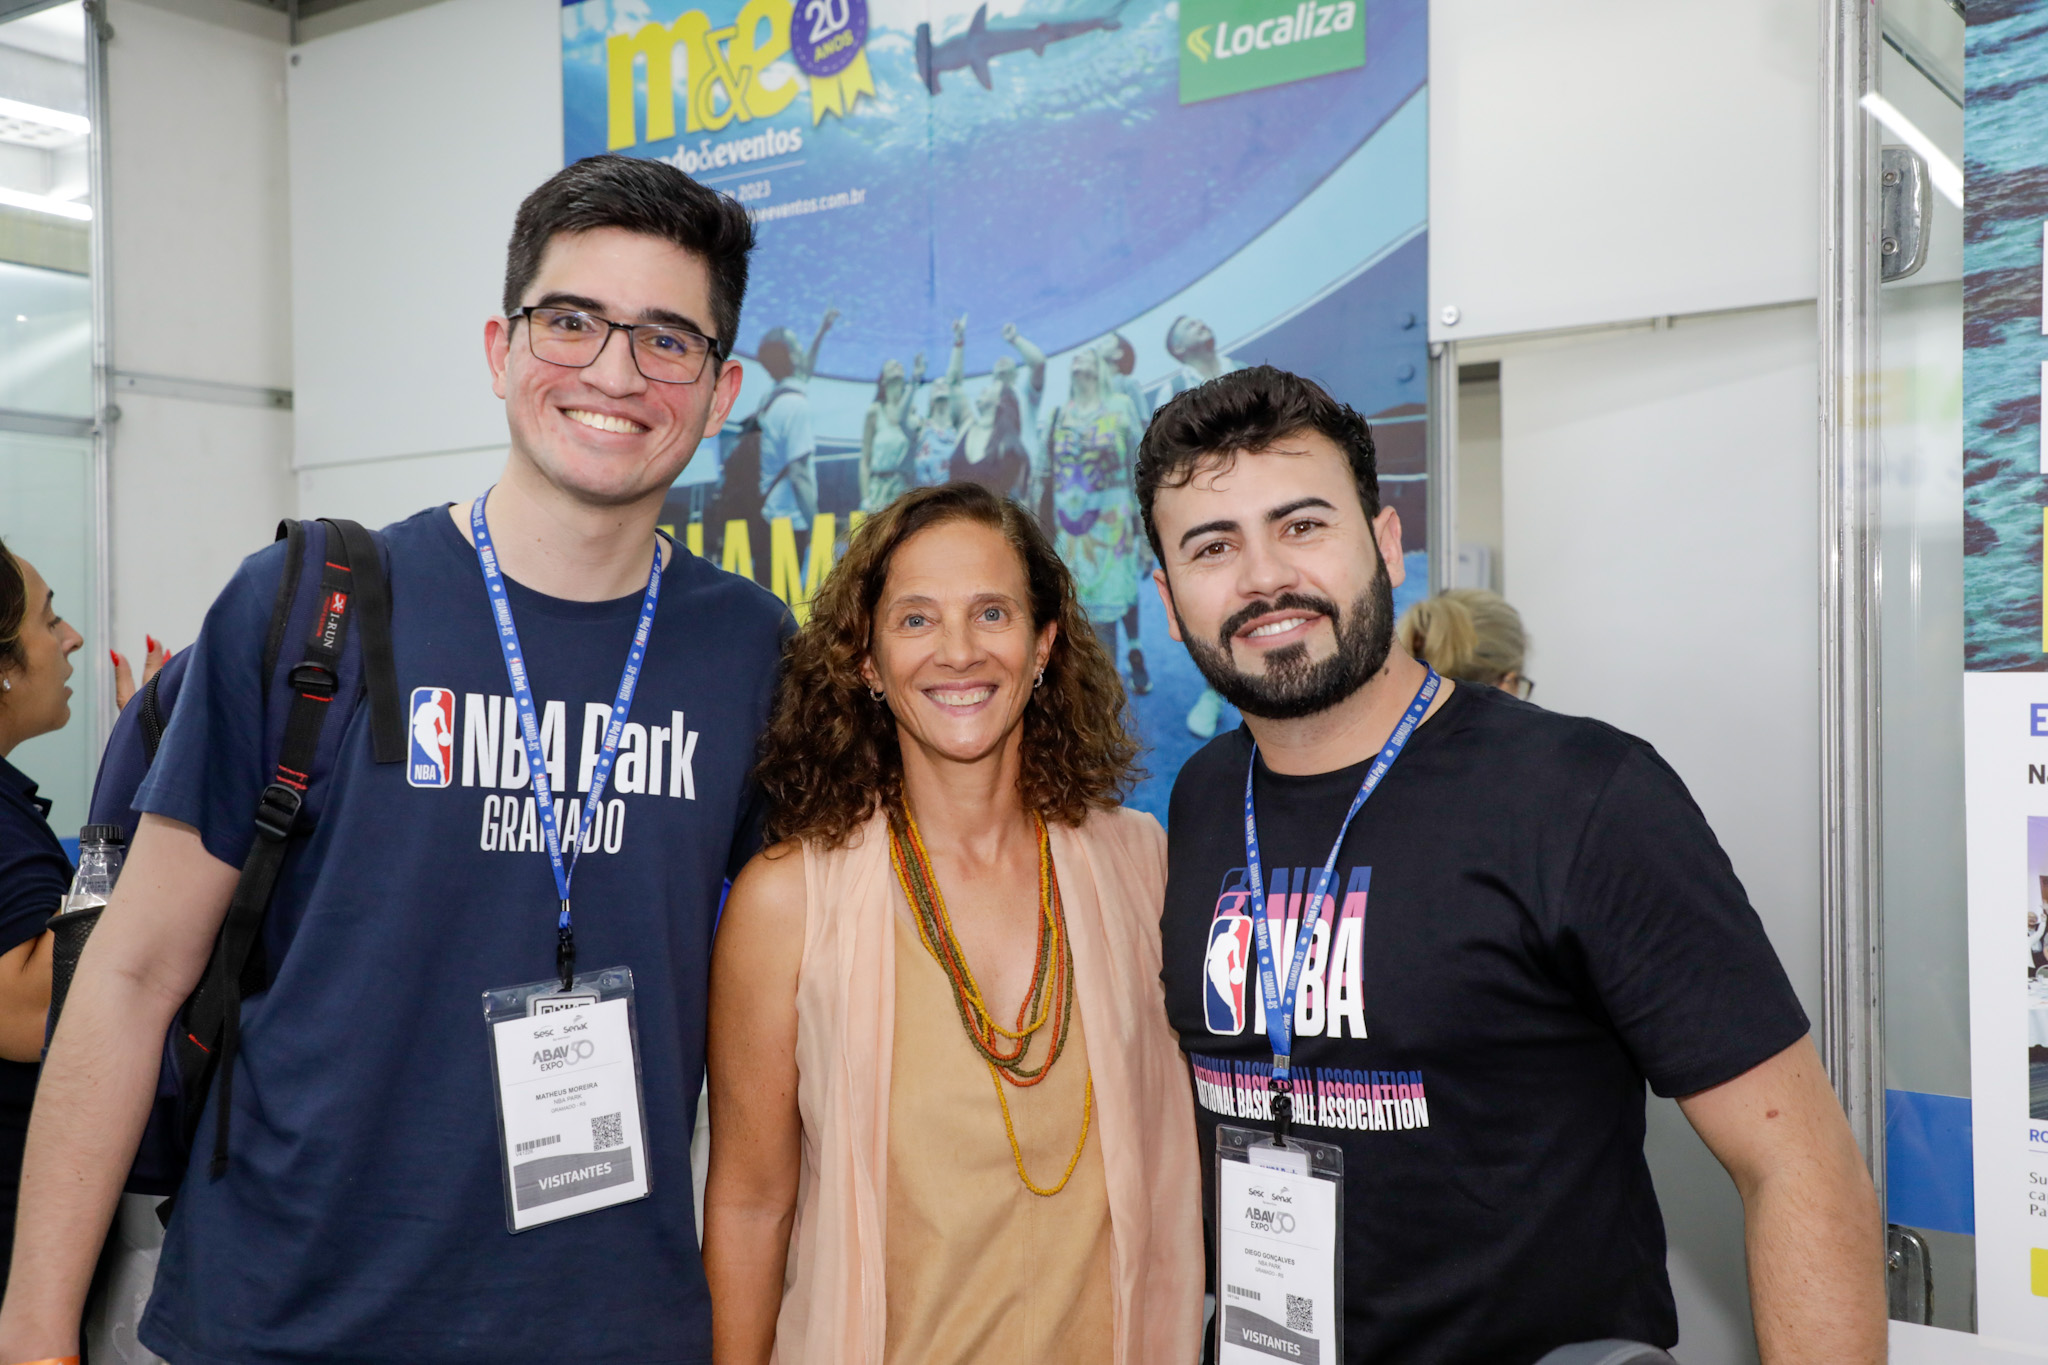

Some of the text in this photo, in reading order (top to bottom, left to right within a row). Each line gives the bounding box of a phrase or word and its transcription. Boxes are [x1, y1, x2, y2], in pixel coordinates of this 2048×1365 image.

[805, 0, 850, 44] 20
[1214, 0, 1357, 59] Localiza
[814, 29, 854, 63] ANOS
[607, 0, 799, 151] m&e
[738, 179, 772, 202] 2023
[323, 613, 340, 648] I-RUN
[640, 615, 651, 630] Park
[513, 675, 527, 692] Park
[521, 712, 539, 751] GRAMADO-RS
[608, 720, 622, 736] Park
[461, 693, 699, 800] NBA Park
[414, 764, 437, 781] NBA
[1372, 761, 1388, 777] Park
[538, 791, 550, 807] Park
[588, 772, 606, 810] GRAMADO-RS
[546, 829, 561, 867] GRAMADO-RS
[1311, 894, 1323, 910] Park
[1258, 934, 1269, 950] Park
[1288, 951, 1304, 990] GRAMADO-RS
[1262, 971, 1278, 1010] GRAMADO-RS
[533, 1028, 554, 1039] Sesc
[563, 1022, 588, 1034] Senac
[532, 1040, 594, 1066] ABAV 50
[540, 1060, 564, 1072] EXPO
[535, 1082, 598, 1101] MATHEUS MOREIRA
[567, 1094, 583, 1102] PARK
[1195, 1075, 1237, 1117] NATIONAL
[1318, 1095, 1430, 1131] ASSOCIATION
[538, 1162, 612, 1191] VISITANTES
[1248, 1187, 1265, 1198] Sesc
[1271, 1193, 1292, 1204] Senac
[1245, 1207, 1296, 1234] ABAV 50
[1251, 1221, 1269, 1232] EXPO
[1244, 1248, 1295, 1265] DIEGO GONÇALVES
[1242, 1327, 1301, 1356] VISITANTES
